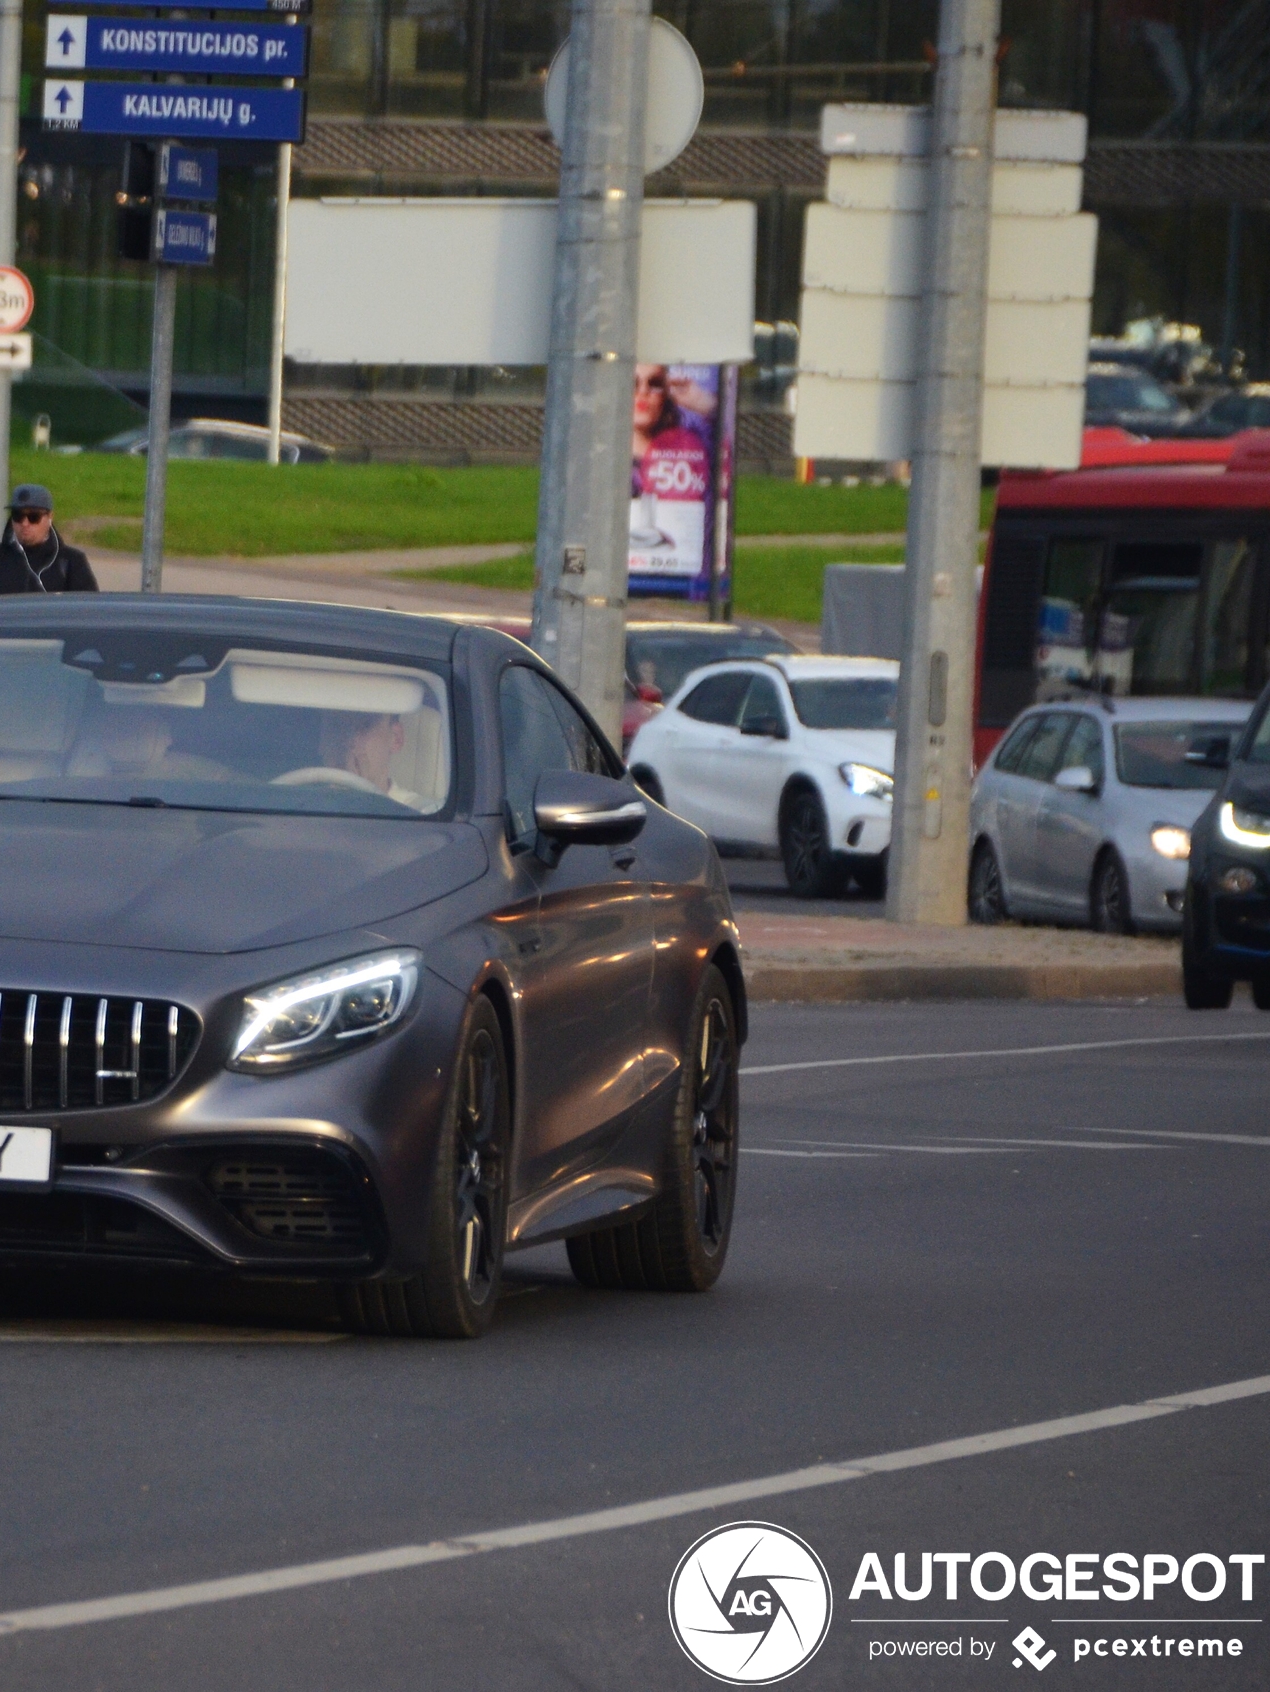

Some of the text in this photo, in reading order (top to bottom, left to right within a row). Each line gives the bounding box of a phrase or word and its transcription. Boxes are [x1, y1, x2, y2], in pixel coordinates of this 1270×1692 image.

[101, 27, 288, 61] KONSTITUCIJOS pr.
[123, 94, 256, 126] KALVARIJŲ g.
